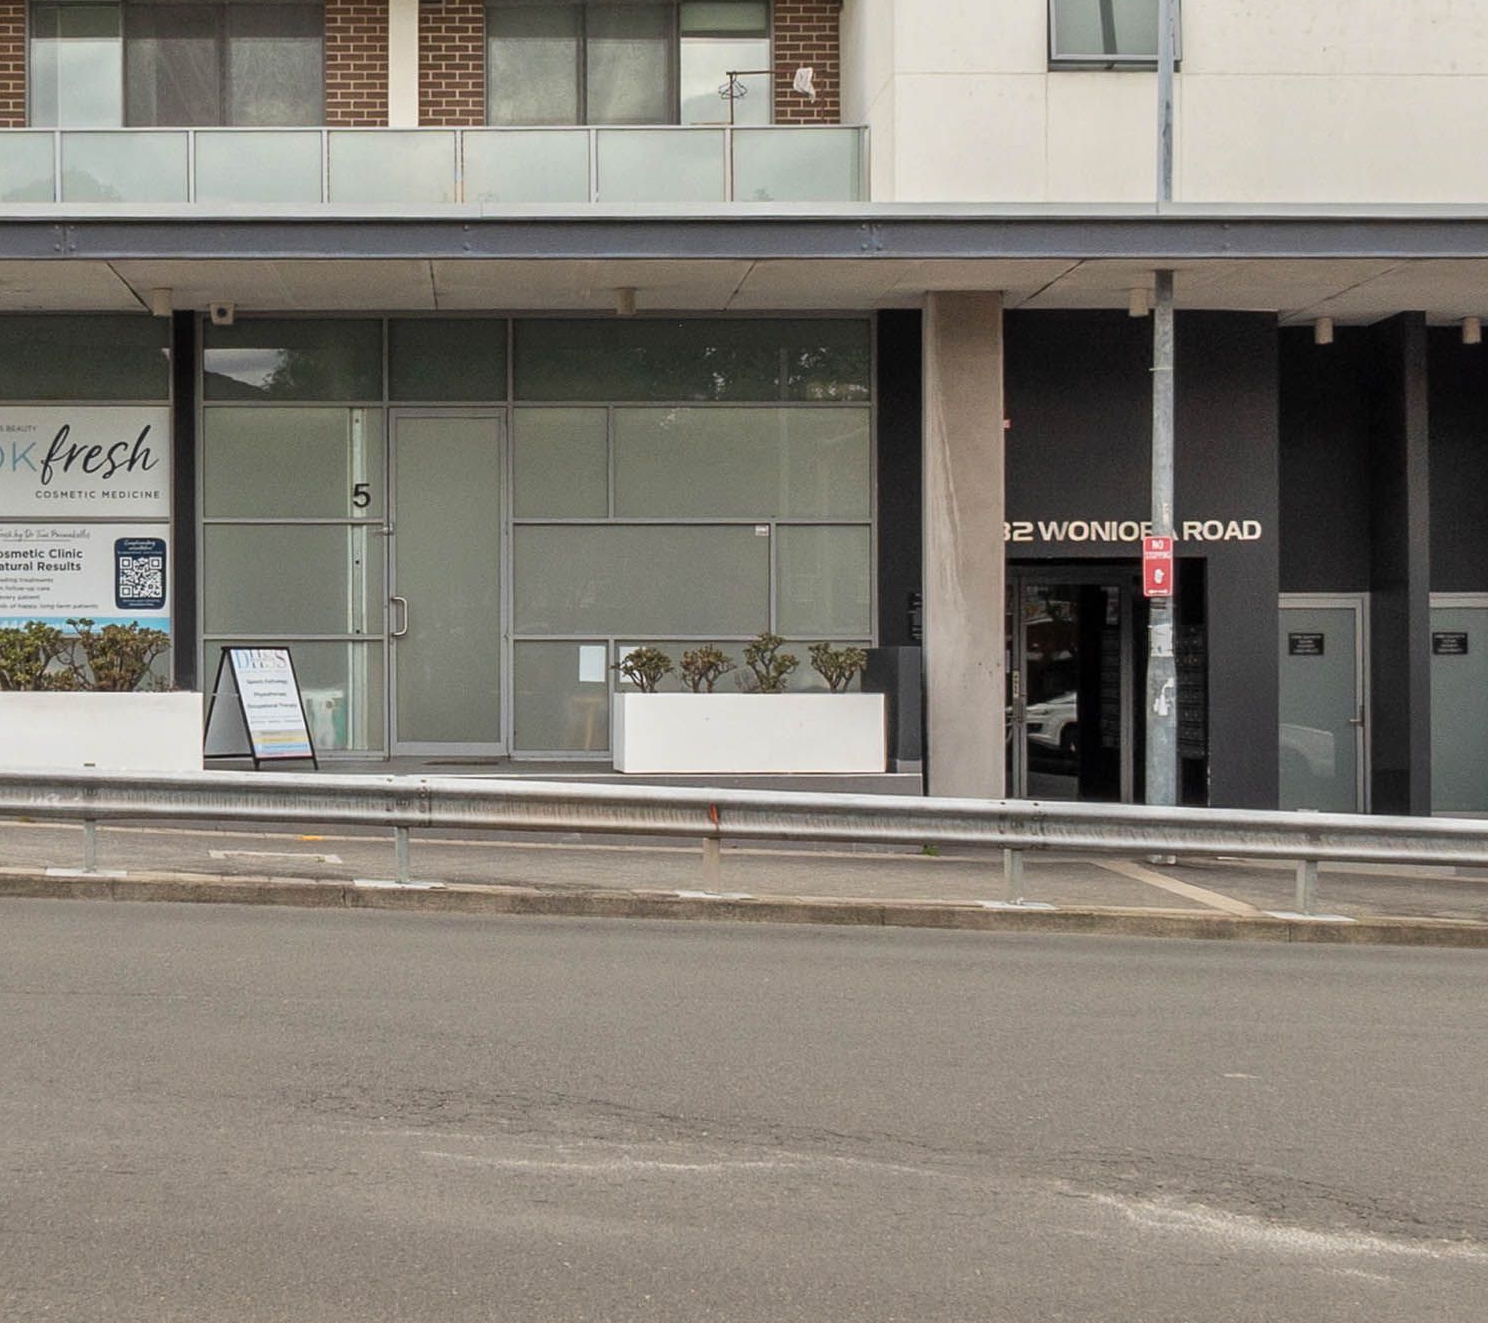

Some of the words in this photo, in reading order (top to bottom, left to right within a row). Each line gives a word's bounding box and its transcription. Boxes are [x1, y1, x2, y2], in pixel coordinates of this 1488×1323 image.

[5, 424, 37, 432] BEAUTY
[35, 490, 96, 499] COSMETIC
[102, 490, 161, 499] MEDICINE
[353, 483, 372, 508] 5
[1183, 520, 1262, 541] ROAD
[48, 548, 84, 559] Clinic
[37, 561, 82, 572] Results
